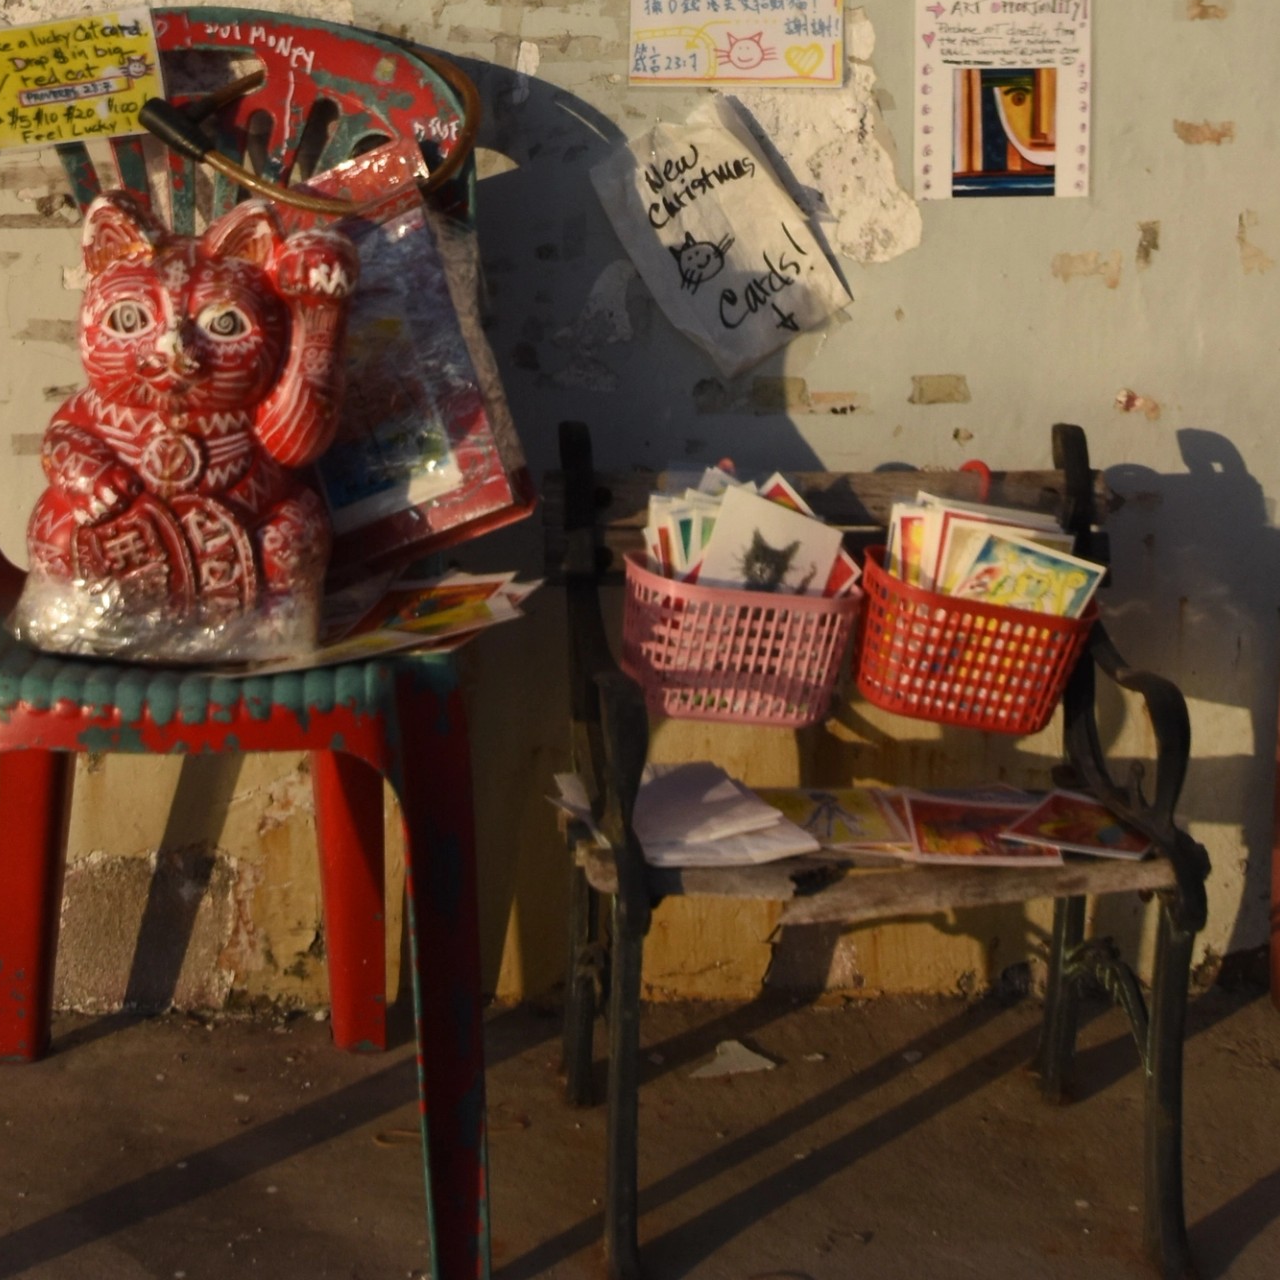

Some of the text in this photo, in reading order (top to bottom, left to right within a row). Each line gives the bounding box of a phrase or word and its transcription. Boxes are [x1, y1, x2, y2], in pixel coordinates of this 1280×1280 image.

[18, 39, 30, 49] a
[30, 30, 71, 47] lucky
[72, 23, 101, 44] Cat
[6, 54, 49, 73] Drop
[72, 50, 88, 61] in
[93, 46, 137, 66] big
[21, 65, 99, 88] red cat
[7, 107, 32, 129] $5
[34, 108, 58, 129] $10
[63, 104, 95, 125] $20
[22, 128, 63, 144] Feel
[644, 143, 699, 194] New
[647, 156, 755, 230] Christmas
